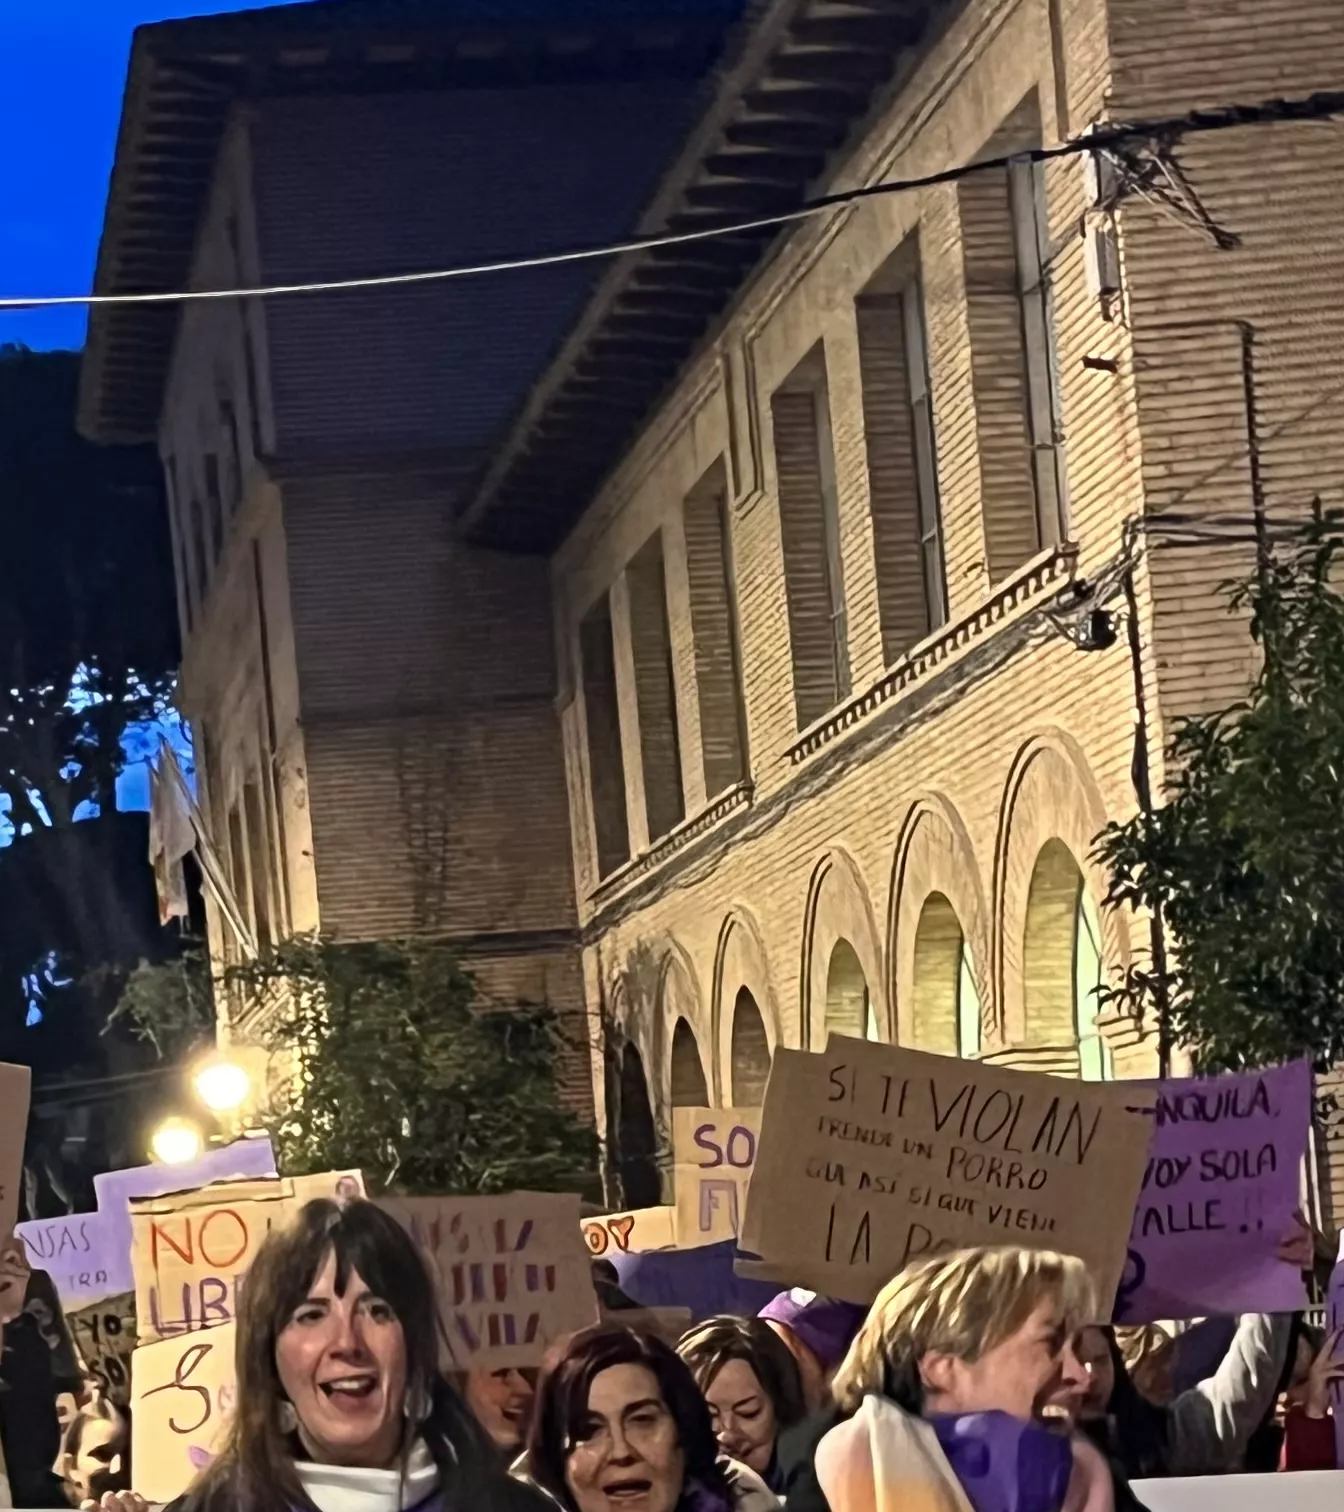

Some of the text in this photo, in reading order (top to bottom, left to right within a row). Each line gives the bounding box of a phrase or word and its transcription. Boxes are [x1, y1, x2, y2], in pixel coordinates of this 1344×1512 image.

[827, 1064, 857, 1106] SI
[929, 1077, 1103, 1166] VIOLAN
[902, 1138, 934, 1160] UN
[945, 1145, 1049, 1191] PORRO
[1199, 1142, 1278, 1183] SOLA
[150, 1208, 249, 1270] NO
[79, 1313, 123, 1344] YO
